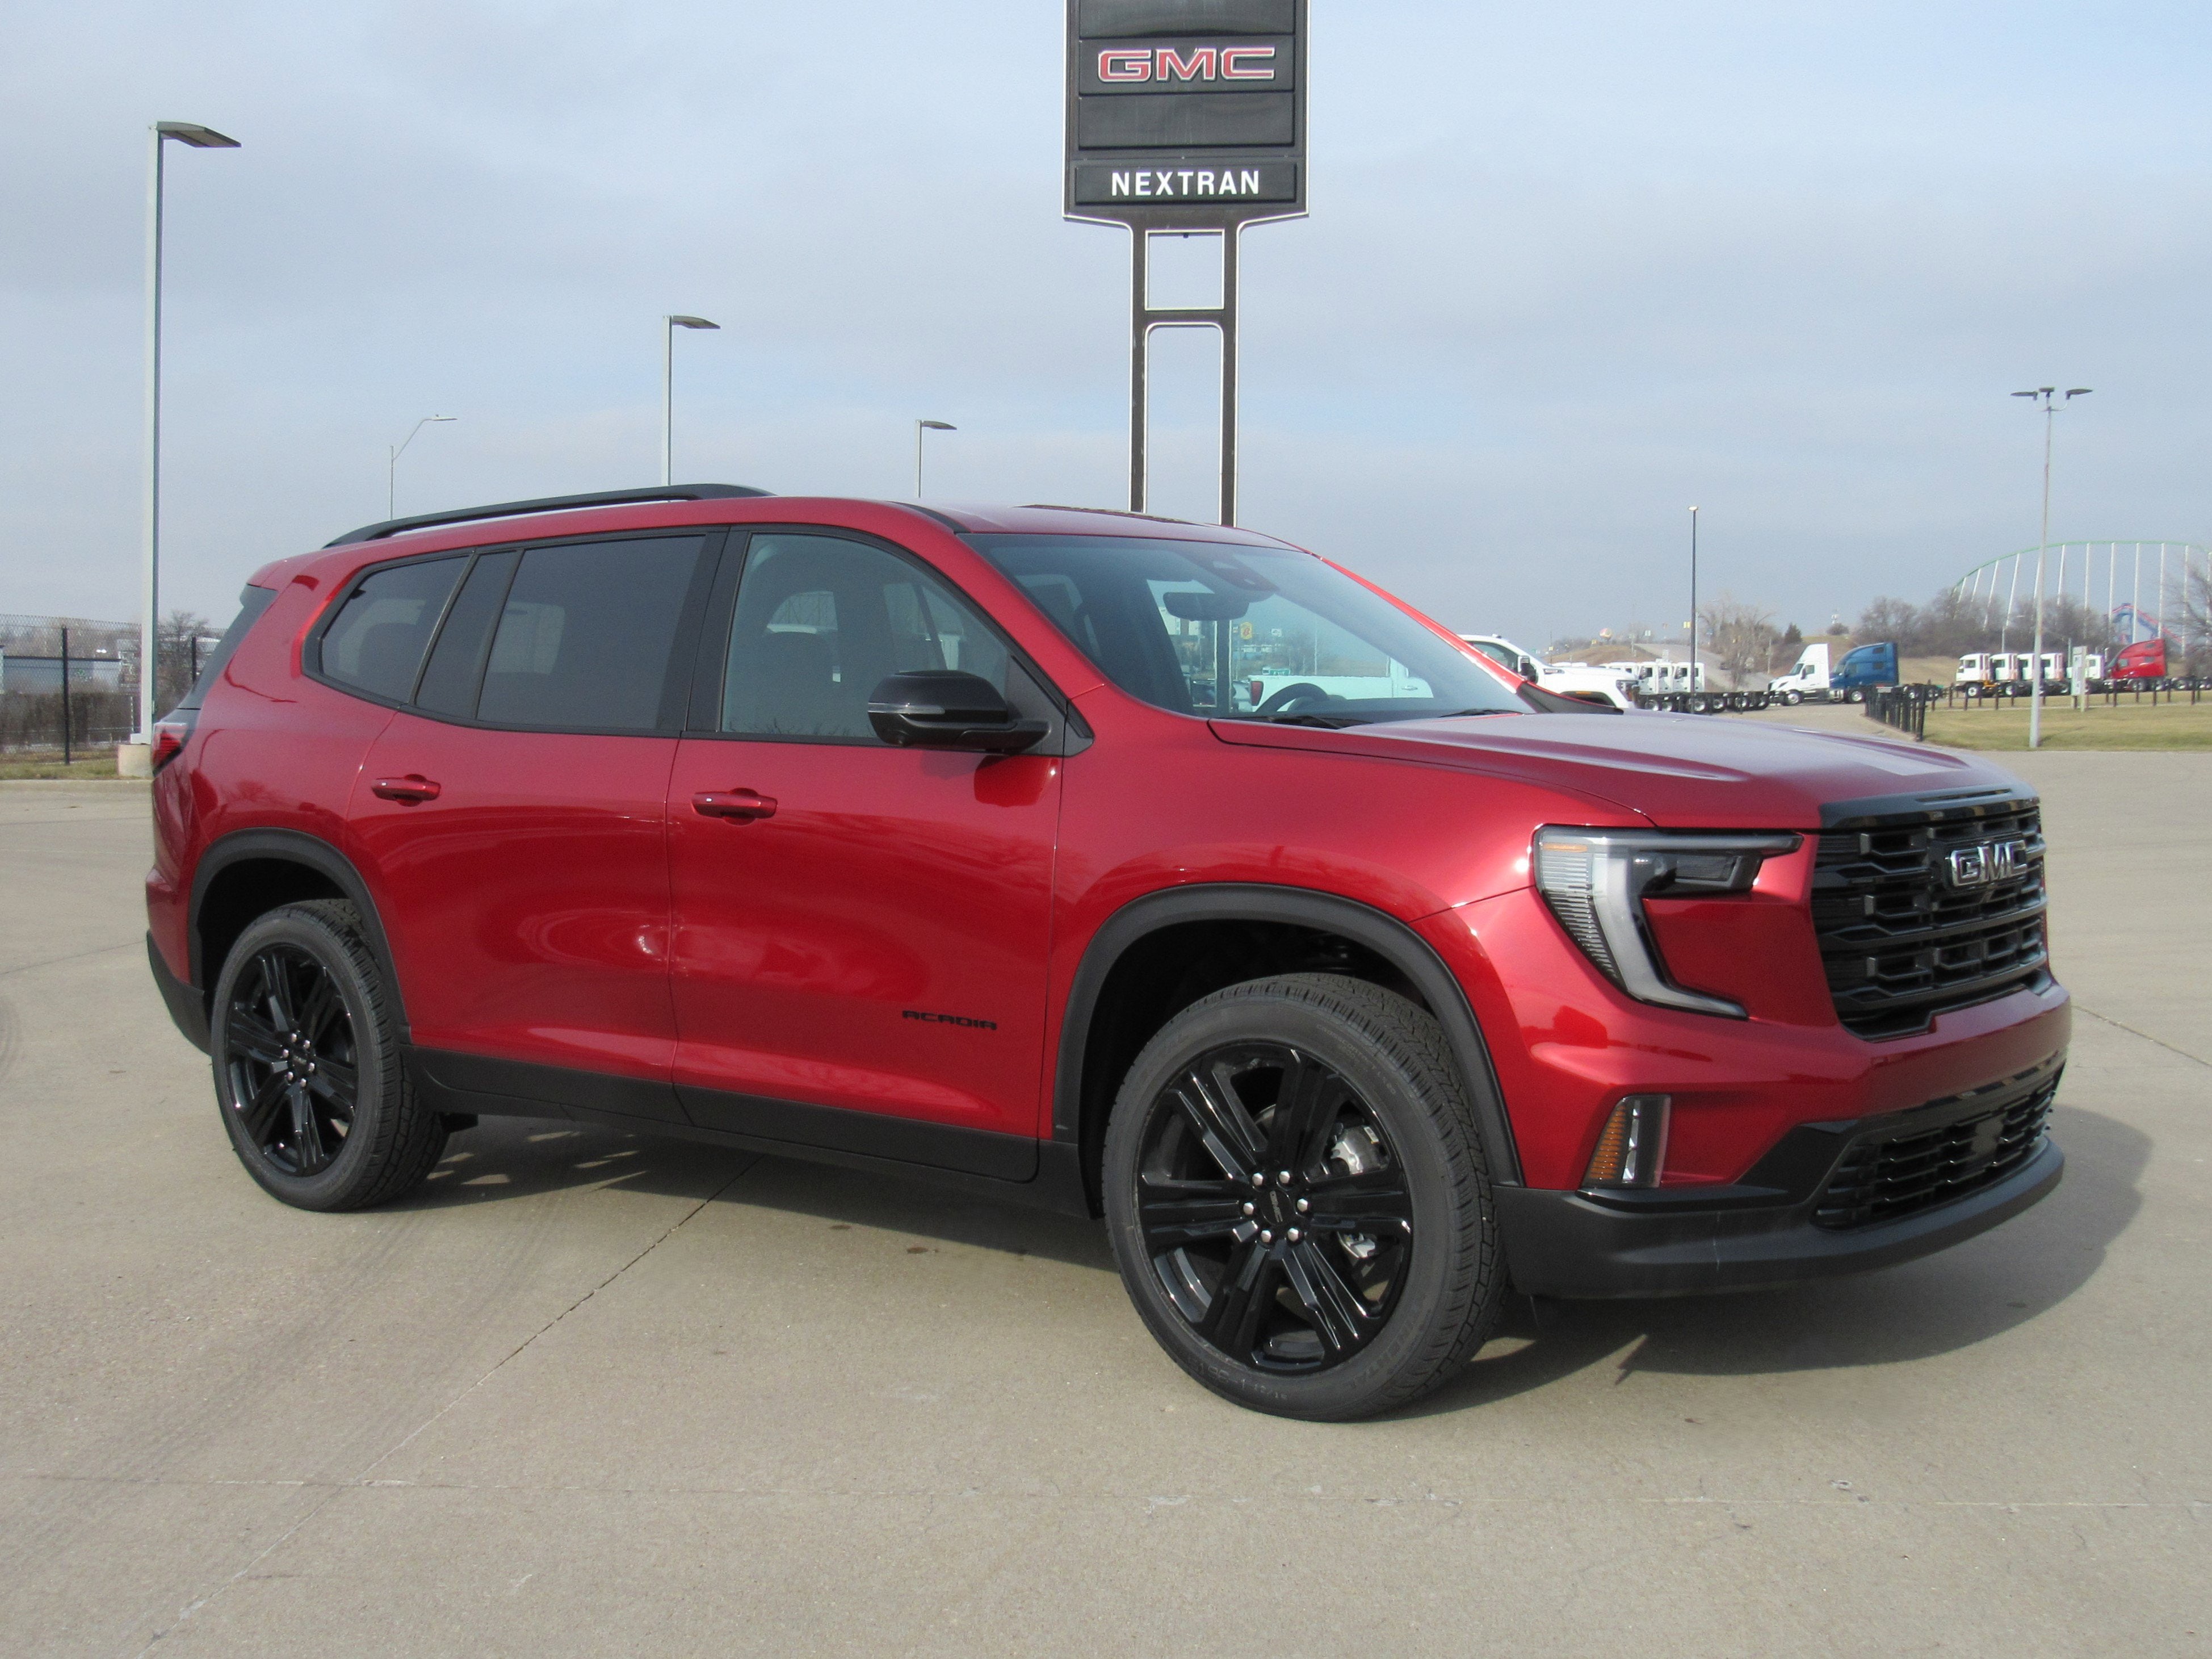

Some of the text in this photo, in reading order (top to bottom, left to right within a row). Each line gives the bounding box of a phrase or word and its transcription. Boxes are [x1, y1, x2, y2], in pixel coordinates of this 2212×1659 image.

[1098, 47, 1275, 82] GMC
[1111, 170, 1259, 196] NEXTRAN
[1950, 840, 2028, 887] GMC
[902, 1010, 997, 1030] ACADIA
